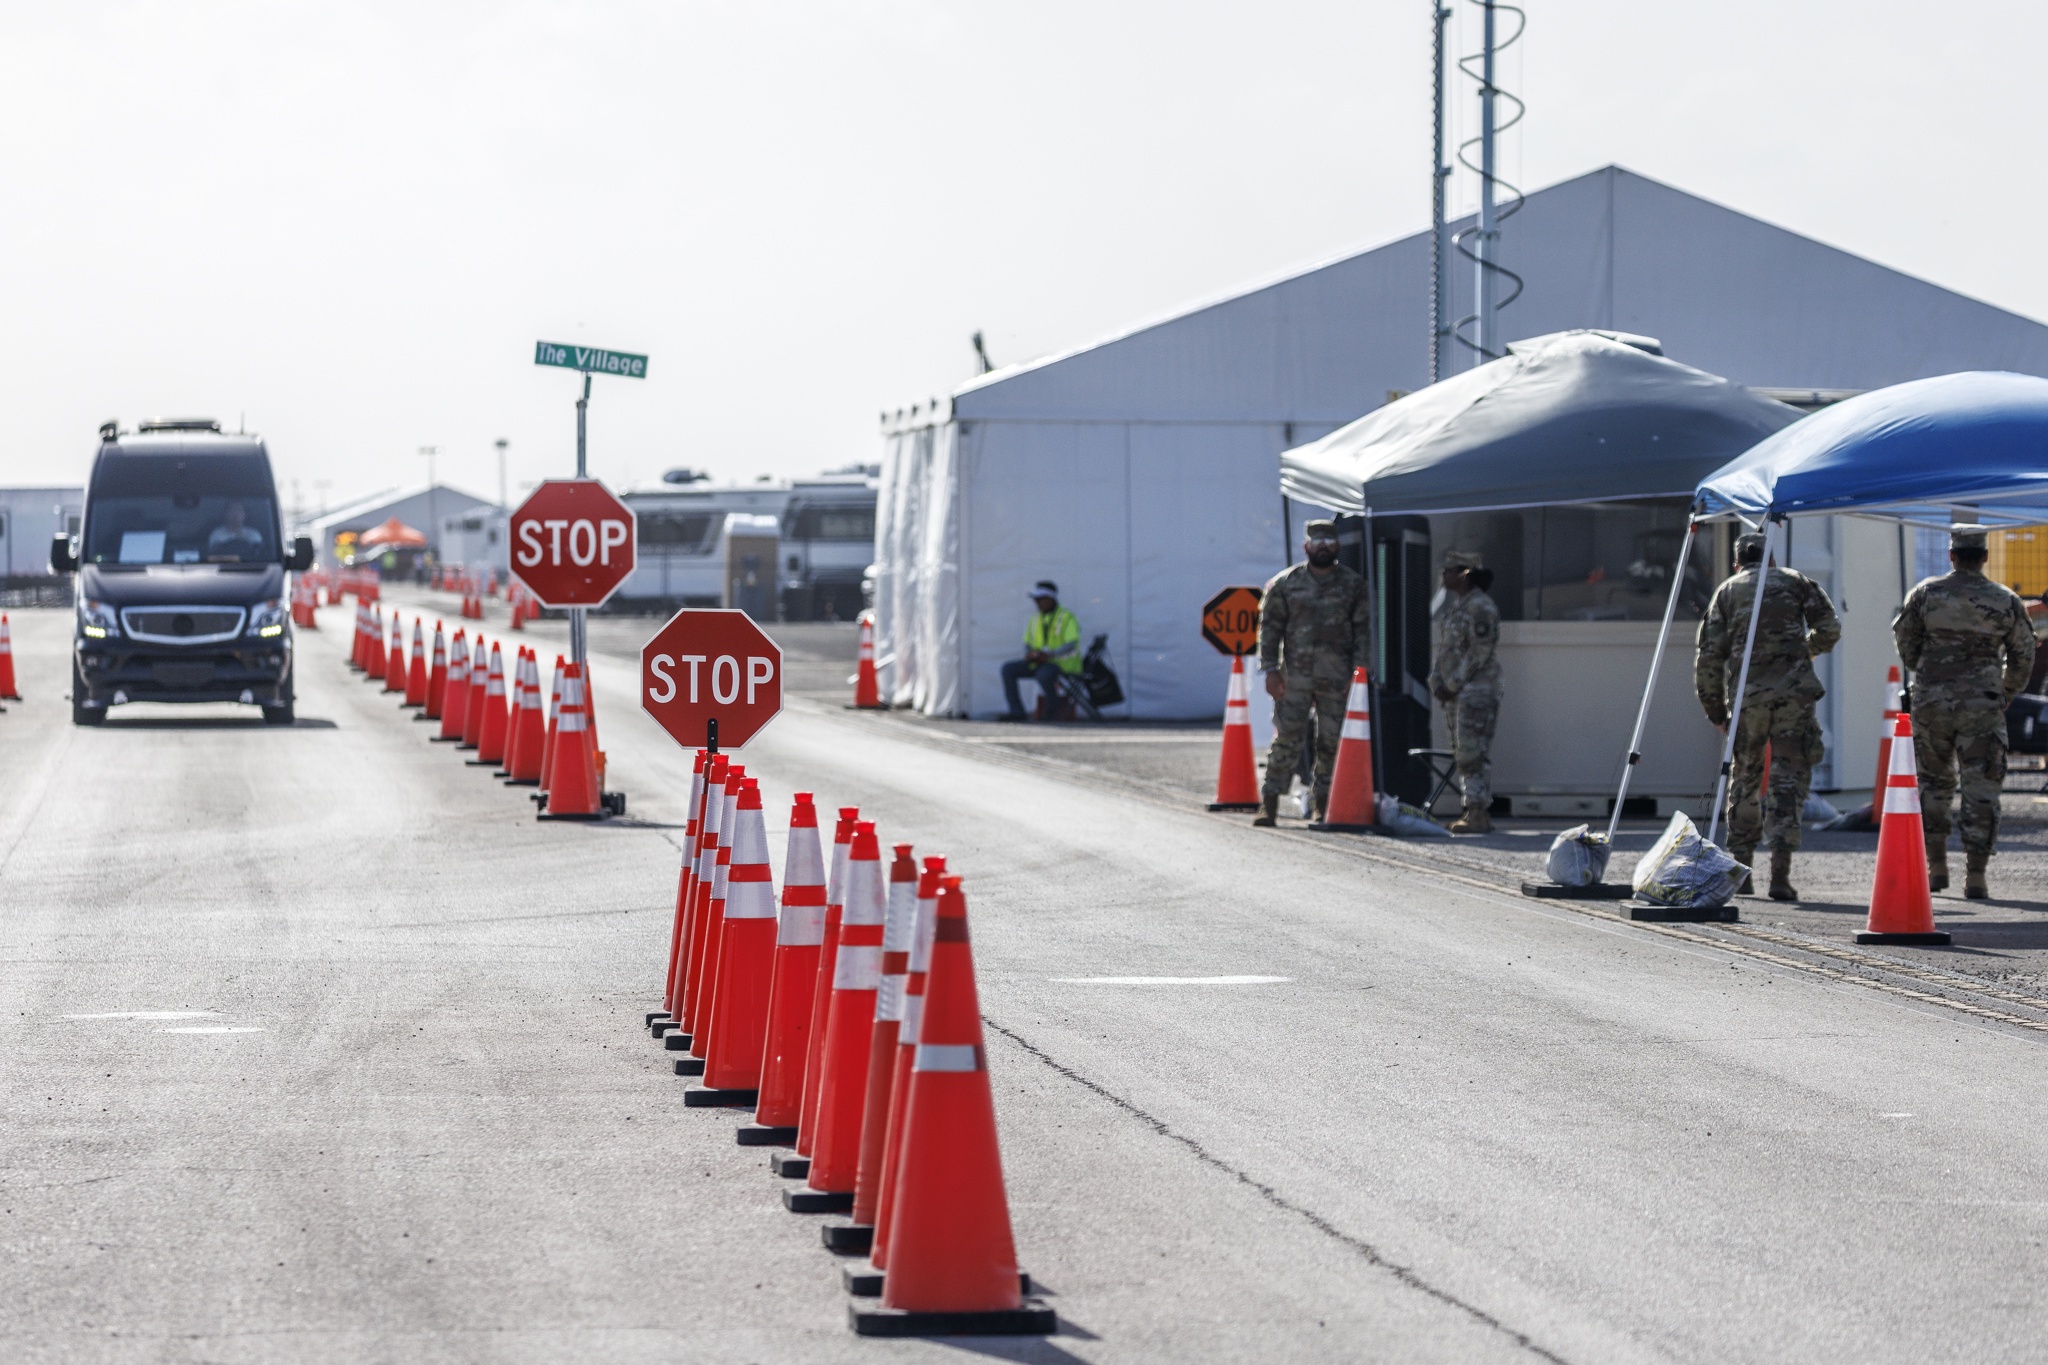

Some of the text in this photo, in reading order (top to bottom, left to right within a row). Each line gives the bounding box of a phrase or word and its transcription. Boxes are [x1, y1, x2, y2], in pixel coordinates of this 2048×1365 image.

[539, 343, 644, 376] The Village
[517, 518, 628, 568] STOP
[649, 653, 775, 705] STOP
